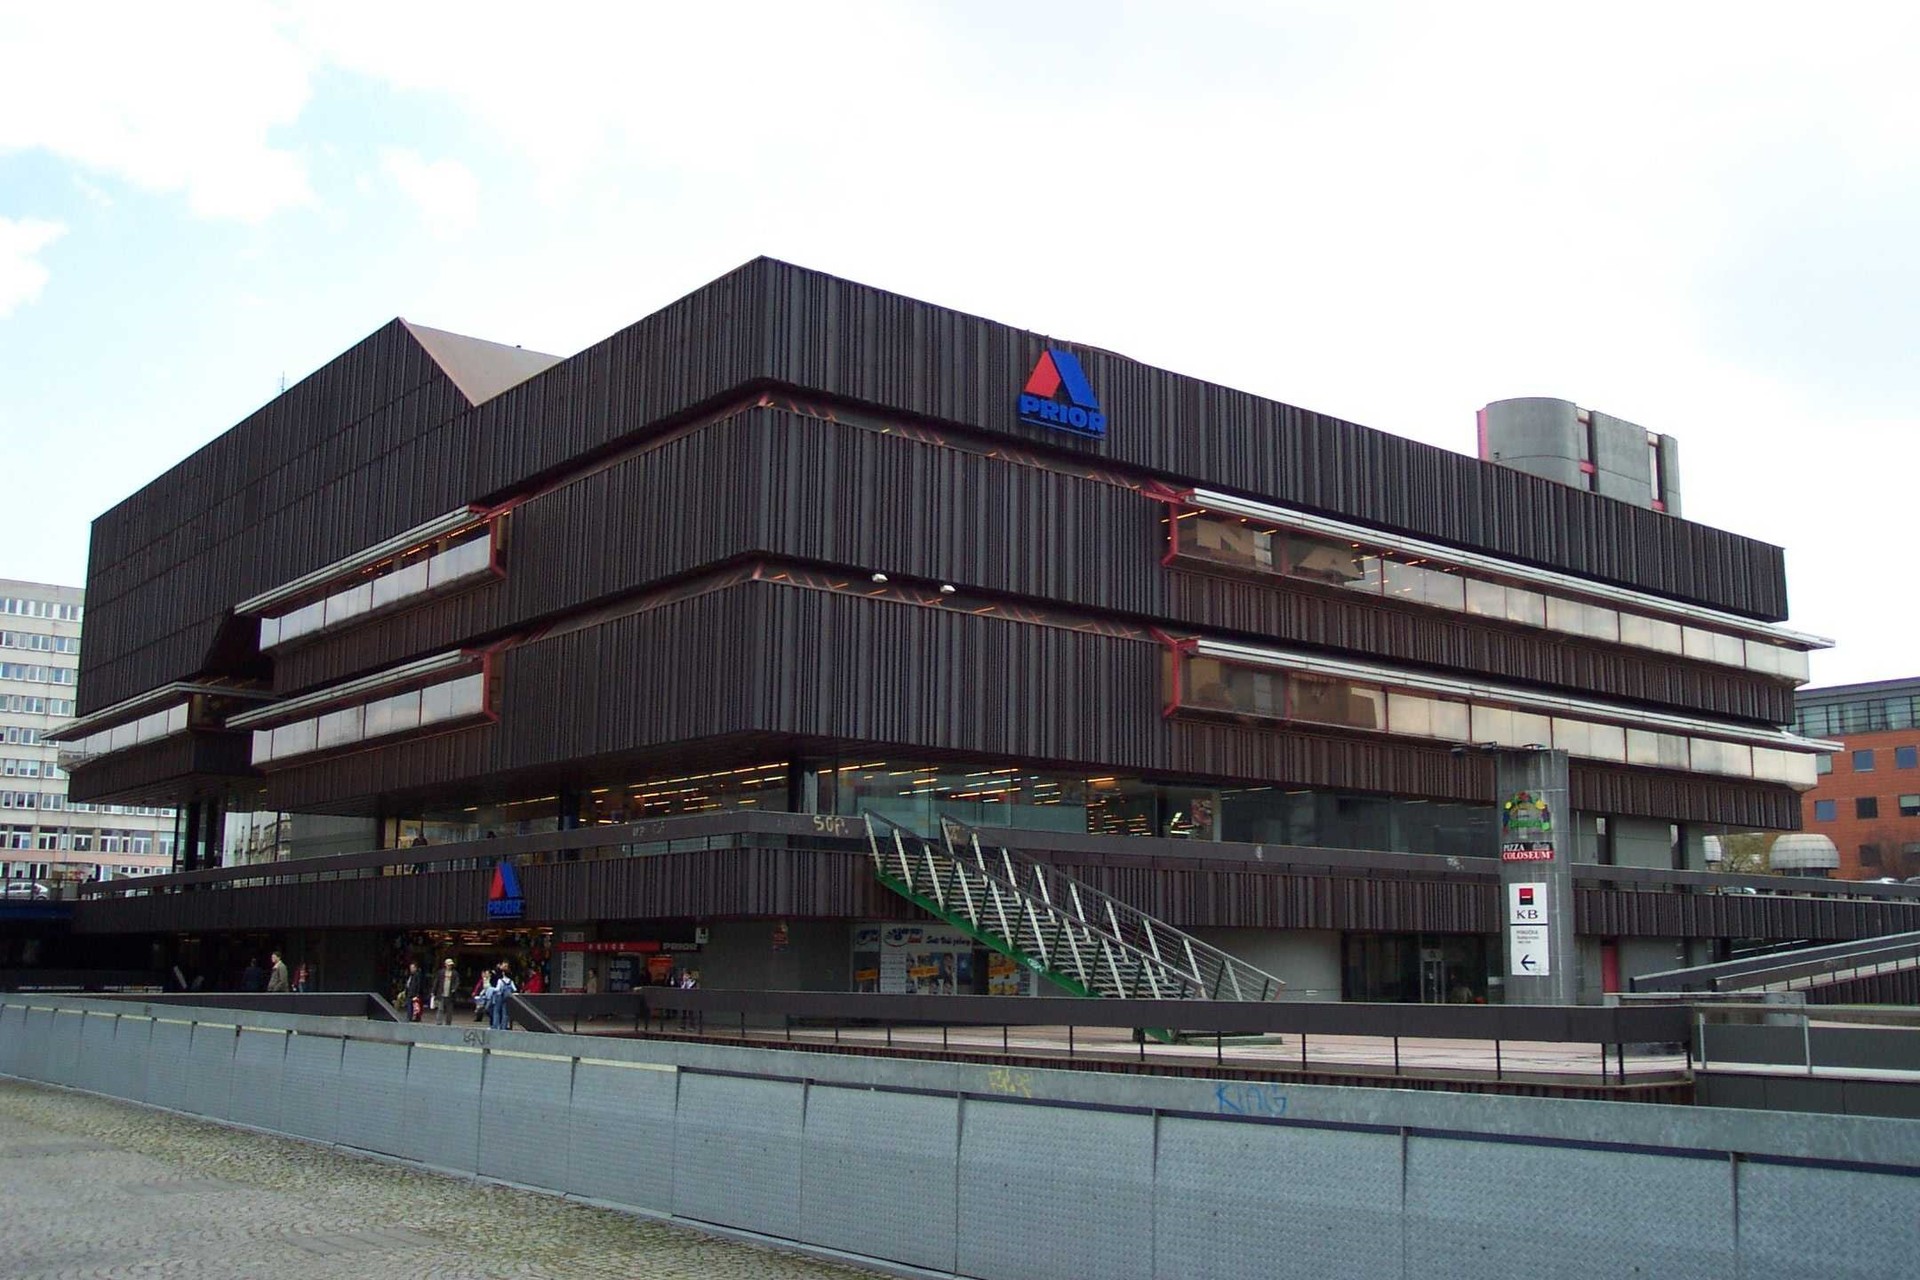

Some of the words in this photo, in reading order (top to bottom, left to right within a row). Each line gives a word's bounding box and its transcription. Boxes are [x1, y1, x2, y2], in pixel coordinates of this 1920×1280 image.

[1019, 394, 1107, 432] PRIOR
[1503, 843, 1525, 851] PIZZA
[1503, 851, 1551, 860] COLOSEUM
[487, 899, 524, 914] PRIOR
[1516, 909, 1539, 920] KB
